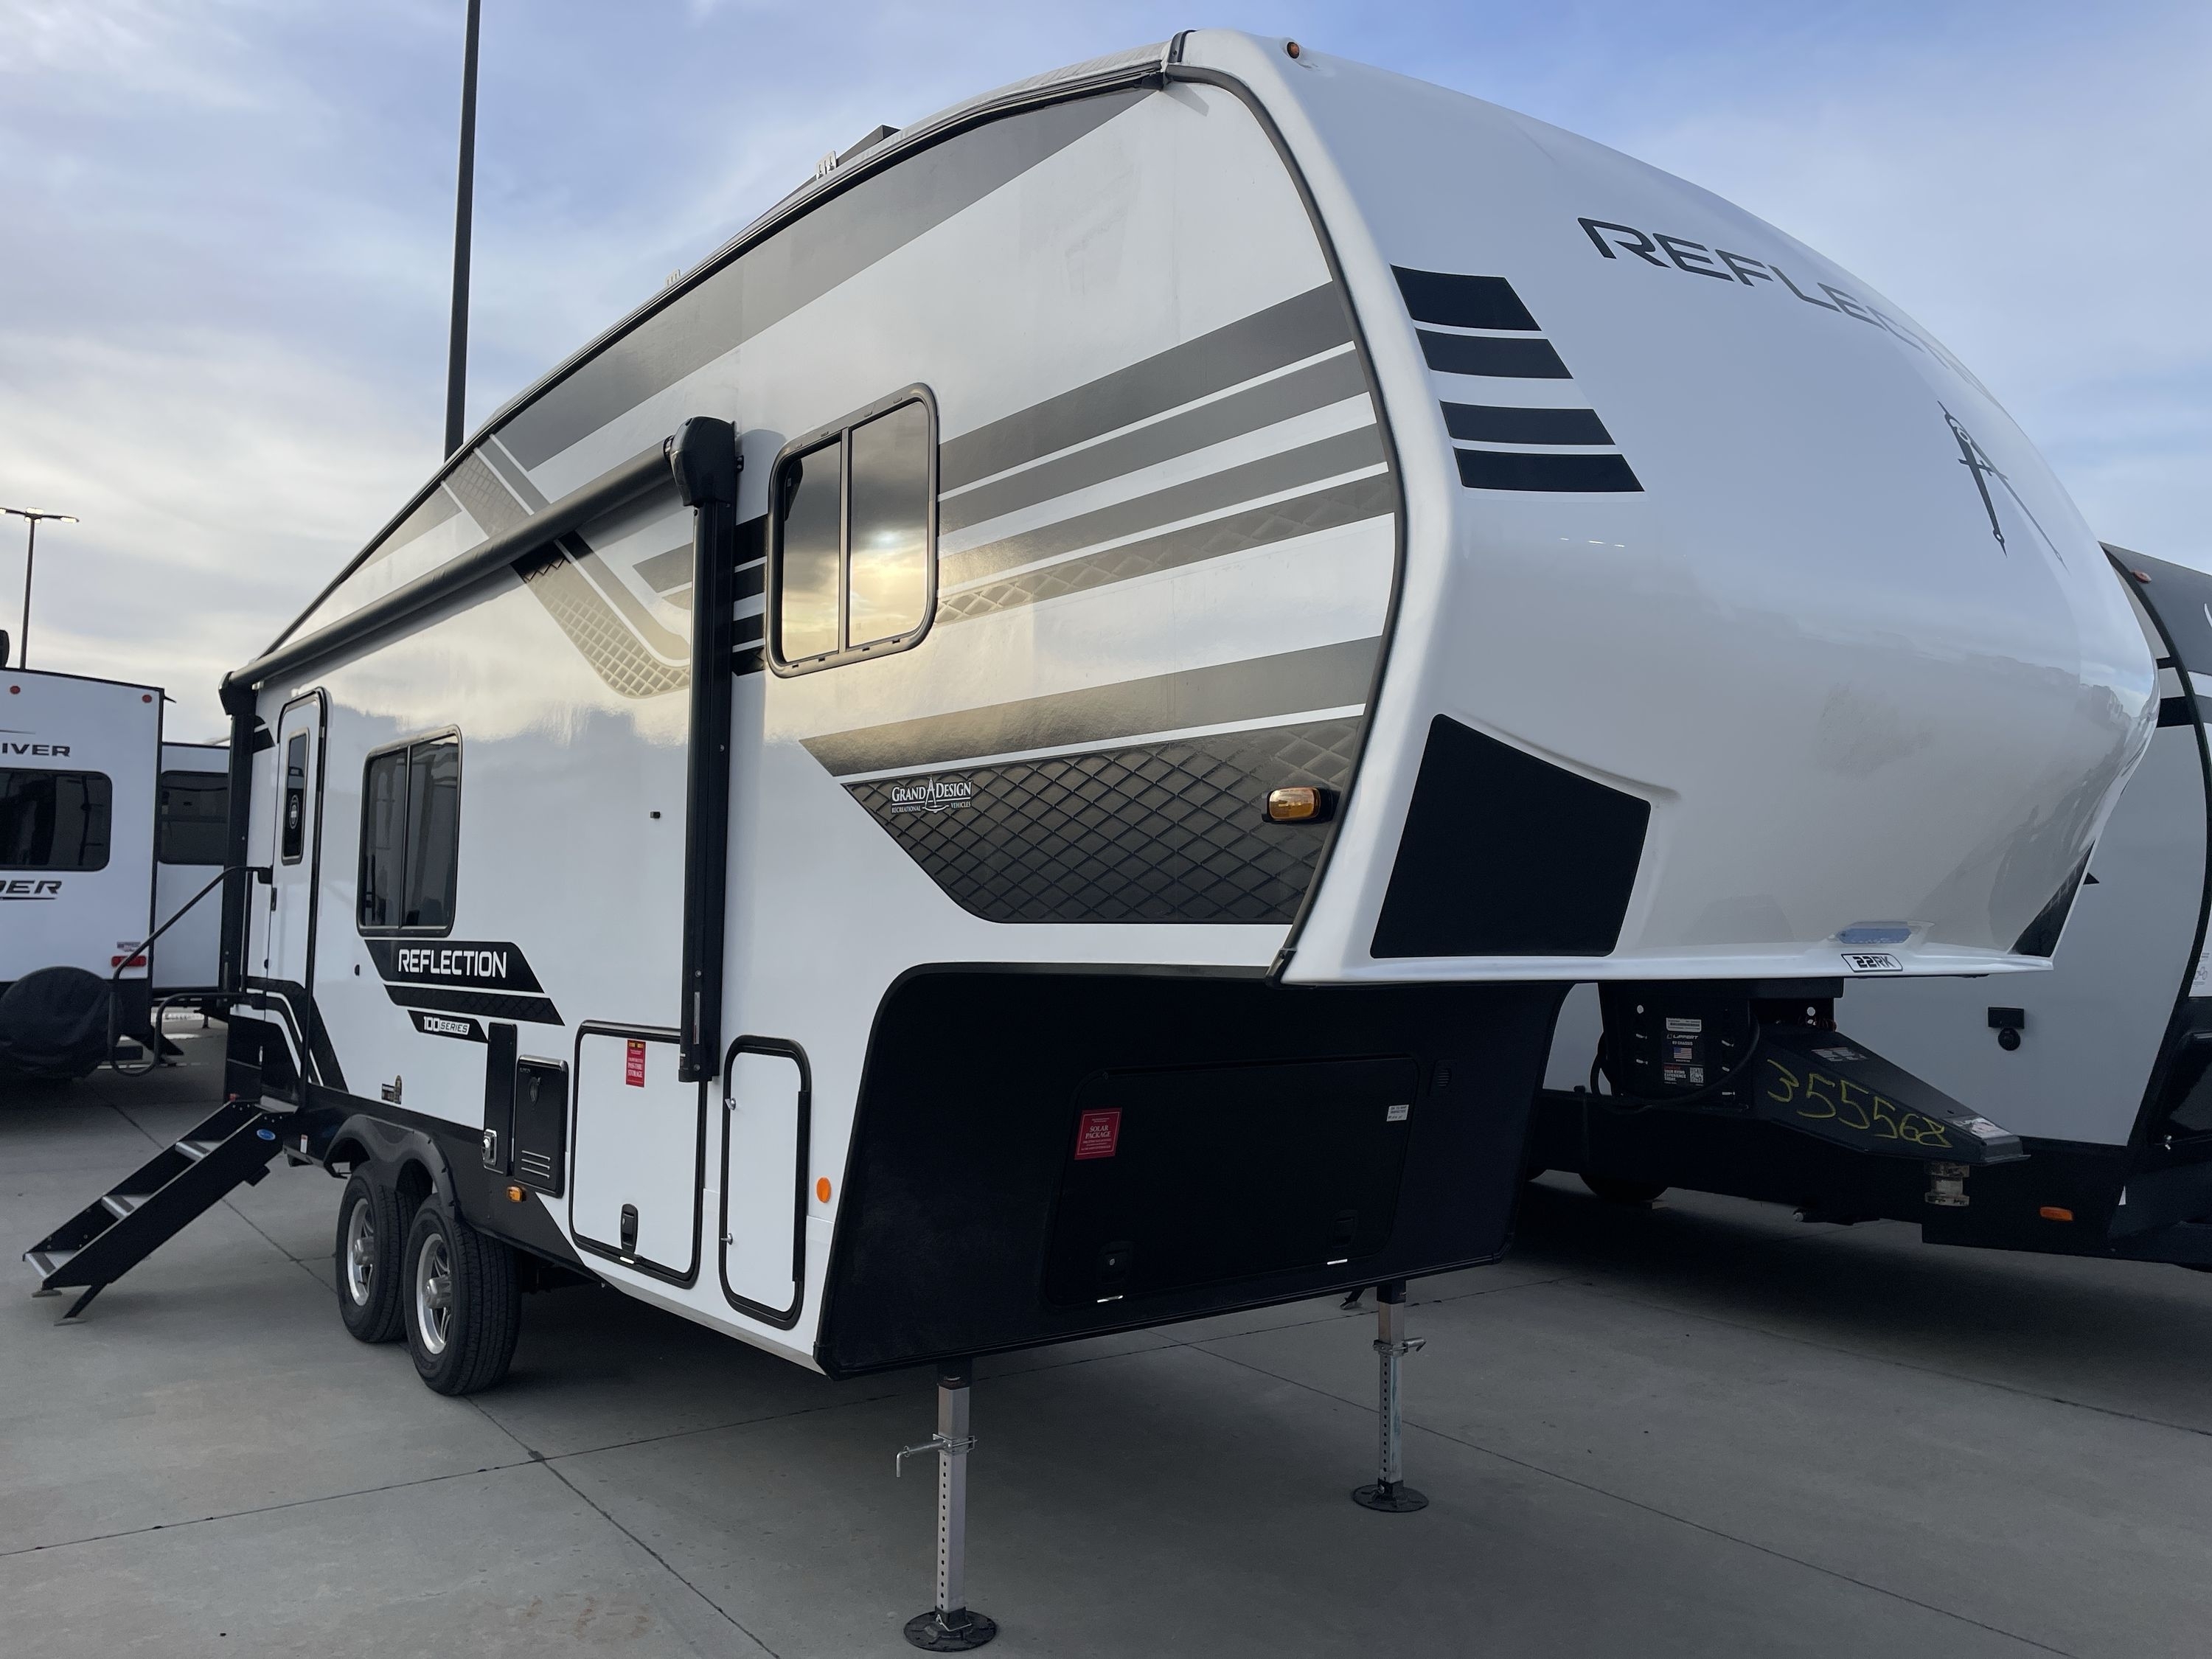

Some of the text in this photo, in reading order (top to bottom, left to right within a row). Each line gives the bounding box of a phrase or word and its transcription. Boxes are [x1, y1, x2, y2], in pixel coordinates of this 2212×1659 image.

[1577, 218, 1991, 400] REFLECT
[891, 782, 972, 802] GRAND DESIGN
[891, 805, 921, 813] RECREATIONAL
[0, 880, 62, 895] ER
[398, 948, 507, 978] REFLECTION
[1852, 956, 1896, 968] 22RK
[423, 1016, 468, 1033] 100 SERIES
[1767, 1059, 1953, 1149] 355568
[1085, 1131, 1111, 1139] PACKAGE
